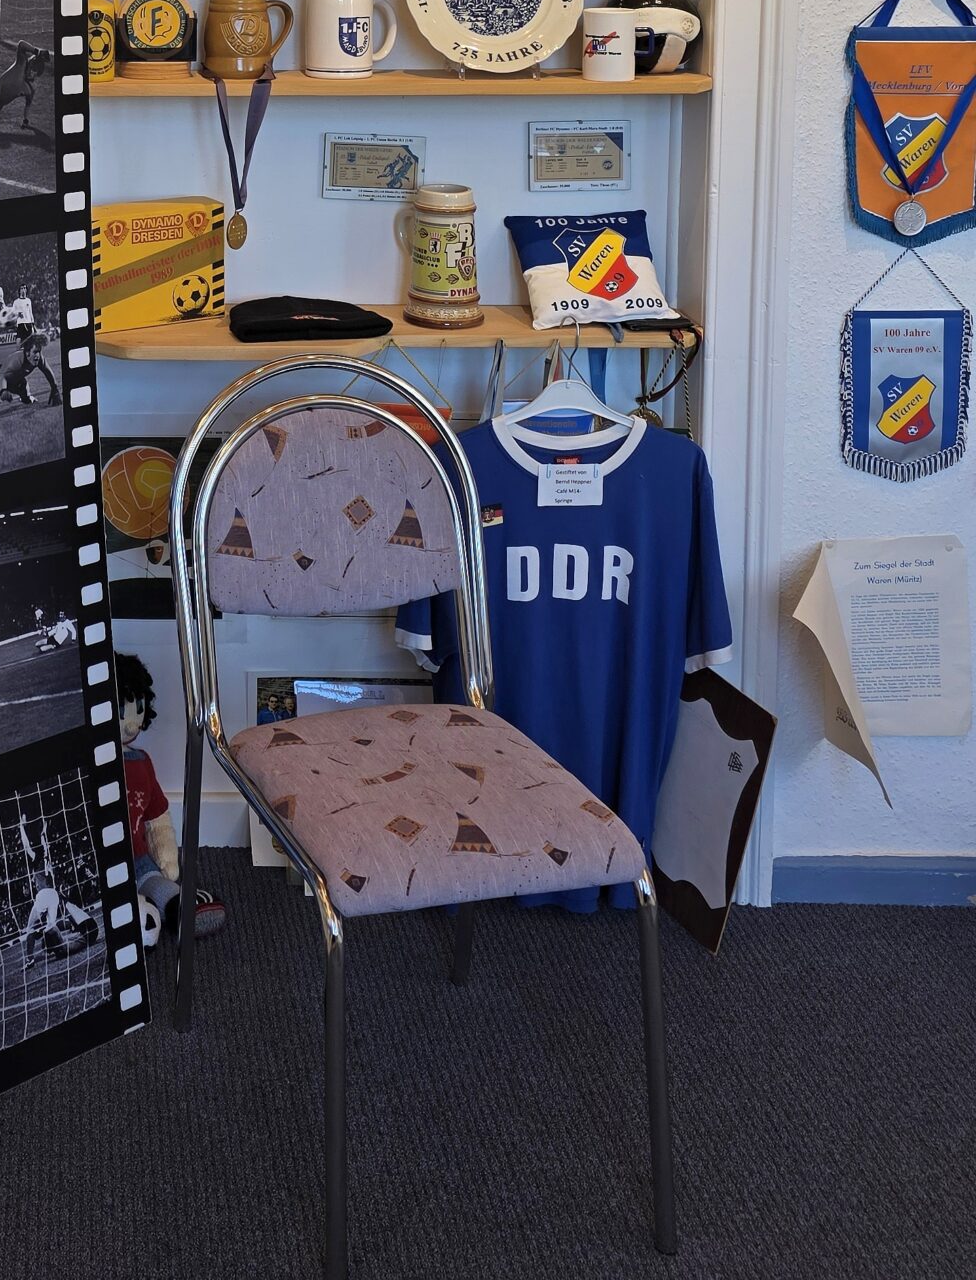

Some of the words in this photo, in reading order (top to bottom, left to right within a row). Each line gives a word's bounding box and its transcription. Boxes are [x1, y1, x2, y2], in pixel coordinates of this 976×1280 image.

[227, 32, 266, 56] DRESDEN
[340, 34, 369, 57] MAGDEBURG
[452, 41, 479, 61] 725
[486, 41, 544, 64] JAHRE
[910, 64, 933, 75] LFV
[896, 123, 914, 147] SV
[900, 136, 938, 171] Waren
[132, 214, 184, 231] DYNAMO
[535, 216, 569, 228] 100
[132, 228, 184, 245] DRESDEN
[567, 234, 588, 258] SV
[94, 254, 176, 293] Fußballmeister
[177, 247, 195, 262] der
[194, 234, 222, 255] DDR
[577, 242, 615, 283] Waren
[150, 266, 174, 285] 1989
[551, 298, 590, 312] 1909
[625, 297, 664, 310] 2009
[884, 327, 900, 337] 100
[903, 327, 931, 337] Jahre
[874, 346, 885, 354] SV
[887, 346, 913, 354] Waren
[915, 346, 924, 354] 09
[926, 346, 941, 354] e.V.
[887, 382, 903, 403] SV
[890, 392, 923, 423] Waren
[505, 542, 634, 606] DDR
[854, 561, 871, 571] Zum
[874, 560, 898, 572] Siegel
[900, 560, 913, 569] der
[914, 559, 935, 569] Stadt
[867, 575, 892, 585] Waren
[894, 574, 923, 586] (Müritz)
